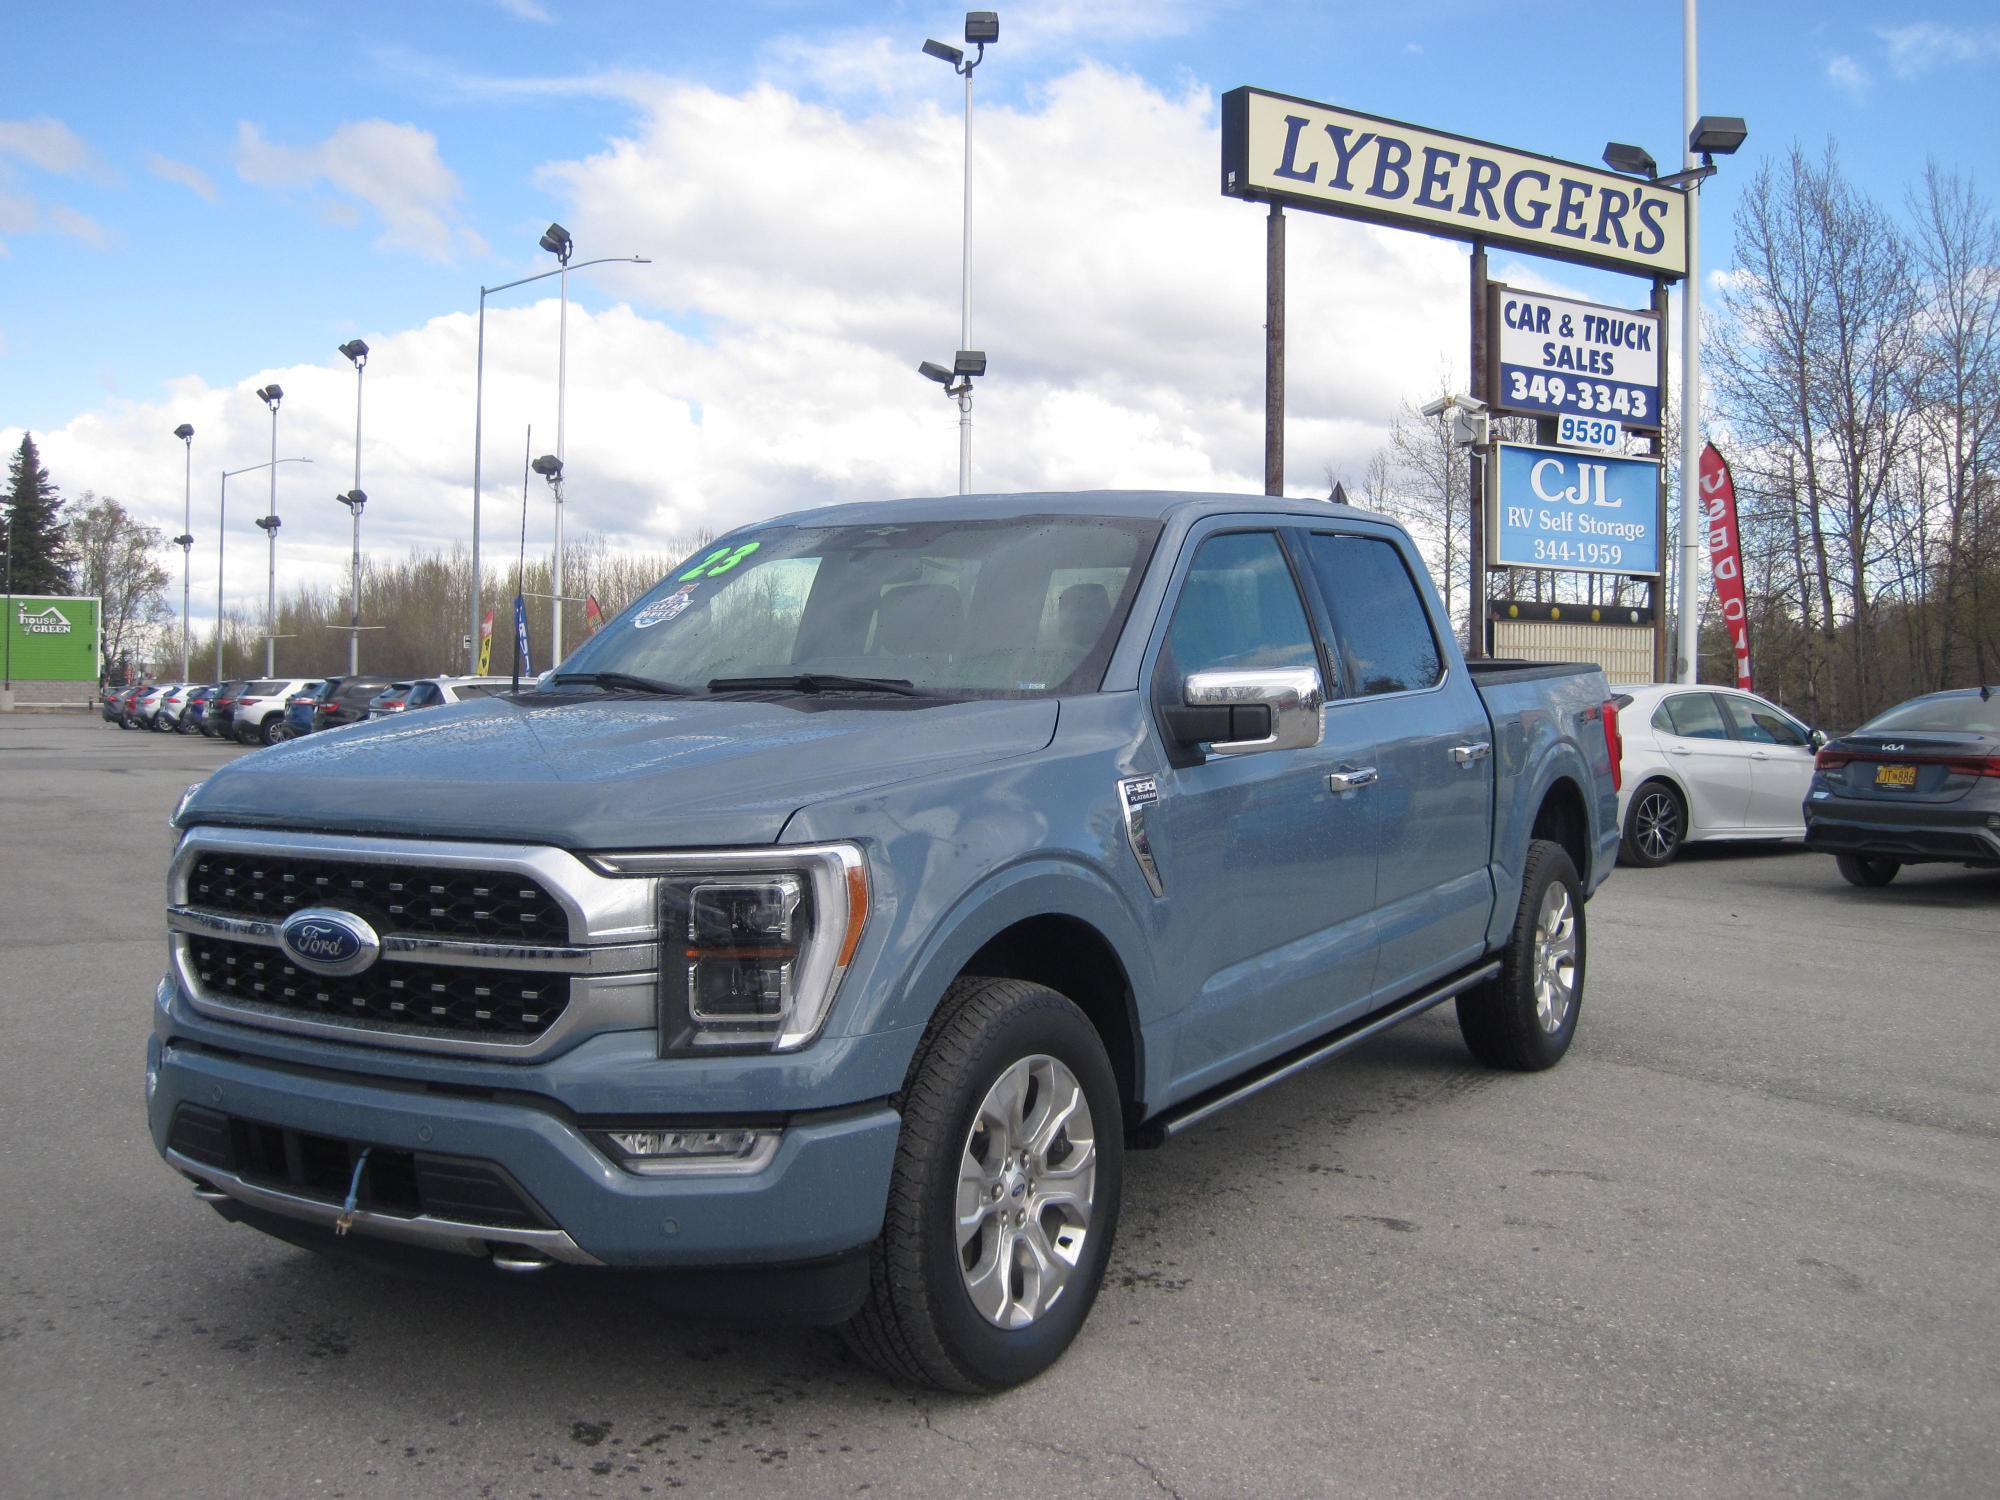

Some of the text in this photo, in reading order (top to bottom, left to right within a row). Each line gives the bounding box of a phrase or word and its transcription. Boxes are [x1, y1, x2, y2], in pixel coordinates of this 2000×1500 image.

[1273, 115, 1669, 255] LYBERGER'S
[1504, 300, 1651, 352] CAR & TRUCK
[1542, 341, 1614, 376] SALES
[1510, 371, 1647, 418] 349-3343
[1561, 418, 1617, 446] 9530
[1530, 458, 1622, 508] CJL
[1508, 506, 1645, 542] RV Self Storage
[679, 542, 760, 581] 23
[1534, 538, 1622, 565] 344-1959
[20, 612, 57, 624] house
[33, 625, 71, 634] GREEN
[1126, 780, 1156, 794] F-150
[1130, 792, 1157, 802] PLATINUM
[297, 925, 343, 956] Ford
